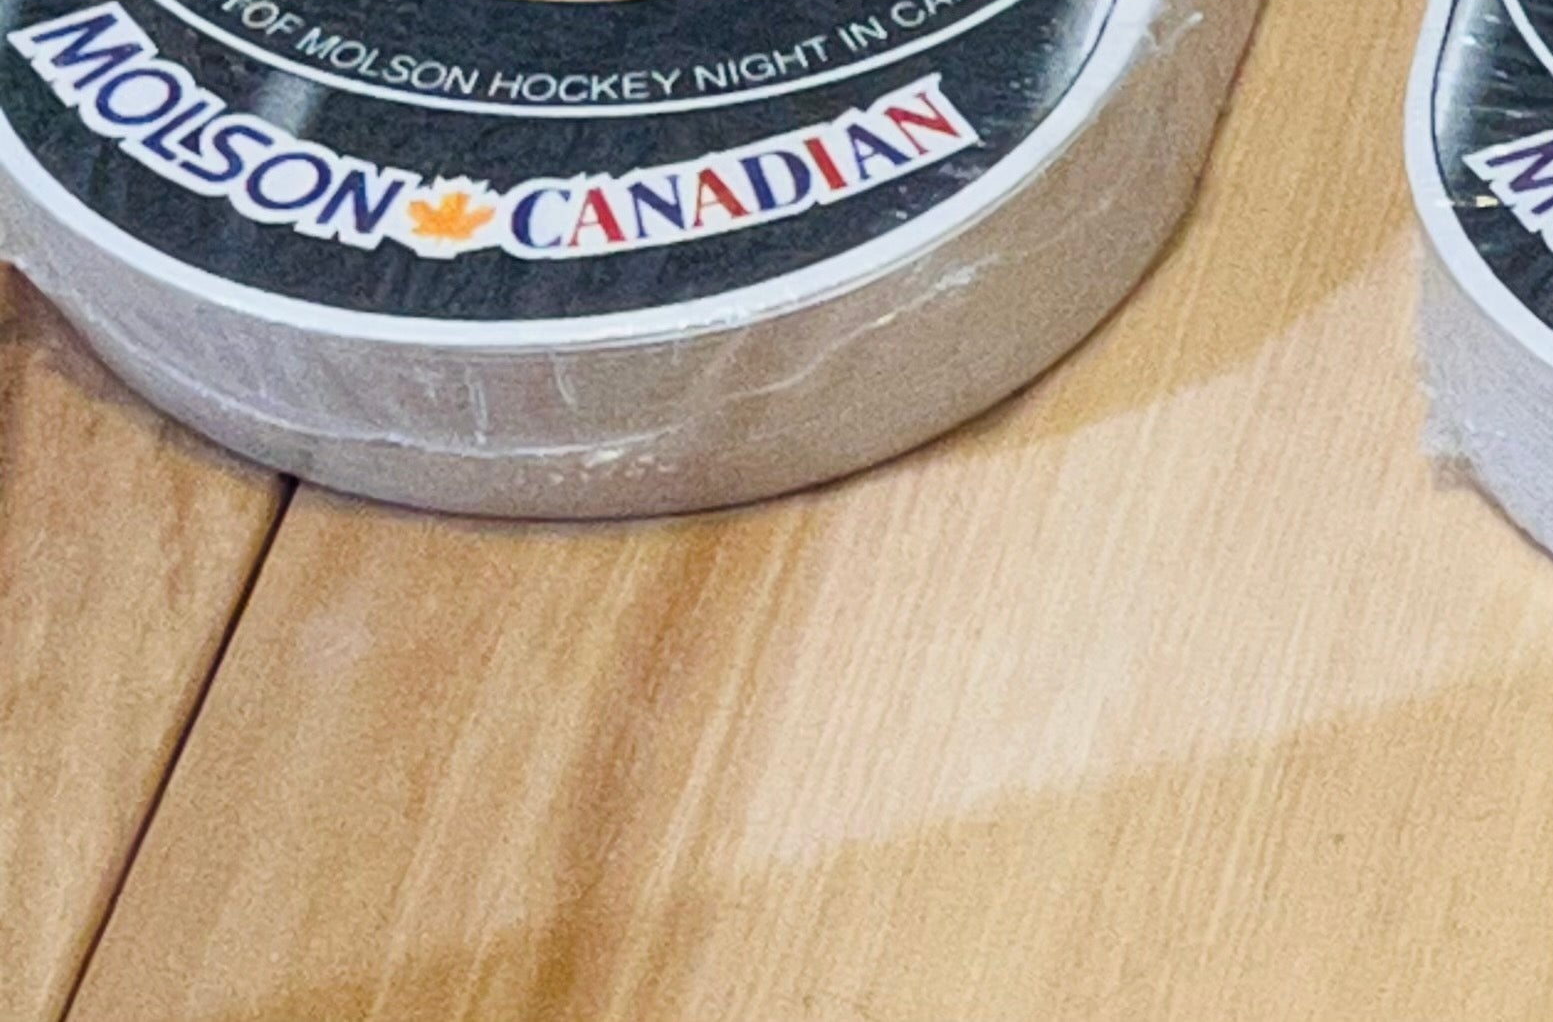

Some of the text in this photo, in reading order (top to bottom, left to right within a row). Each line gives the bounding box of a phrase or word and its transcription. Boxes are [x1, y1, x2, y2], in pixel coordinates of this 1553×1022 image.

[31, 11, 962, 249] MOLSON CANADIAN
[241, 0, 305, 35] OF
[295, 26, 480, 95] MOLSON
[487, 68, 681, 104] HOCKEY
[693, 35, 829, 92] NIGHT
[839, 17, 888, 53] IN
